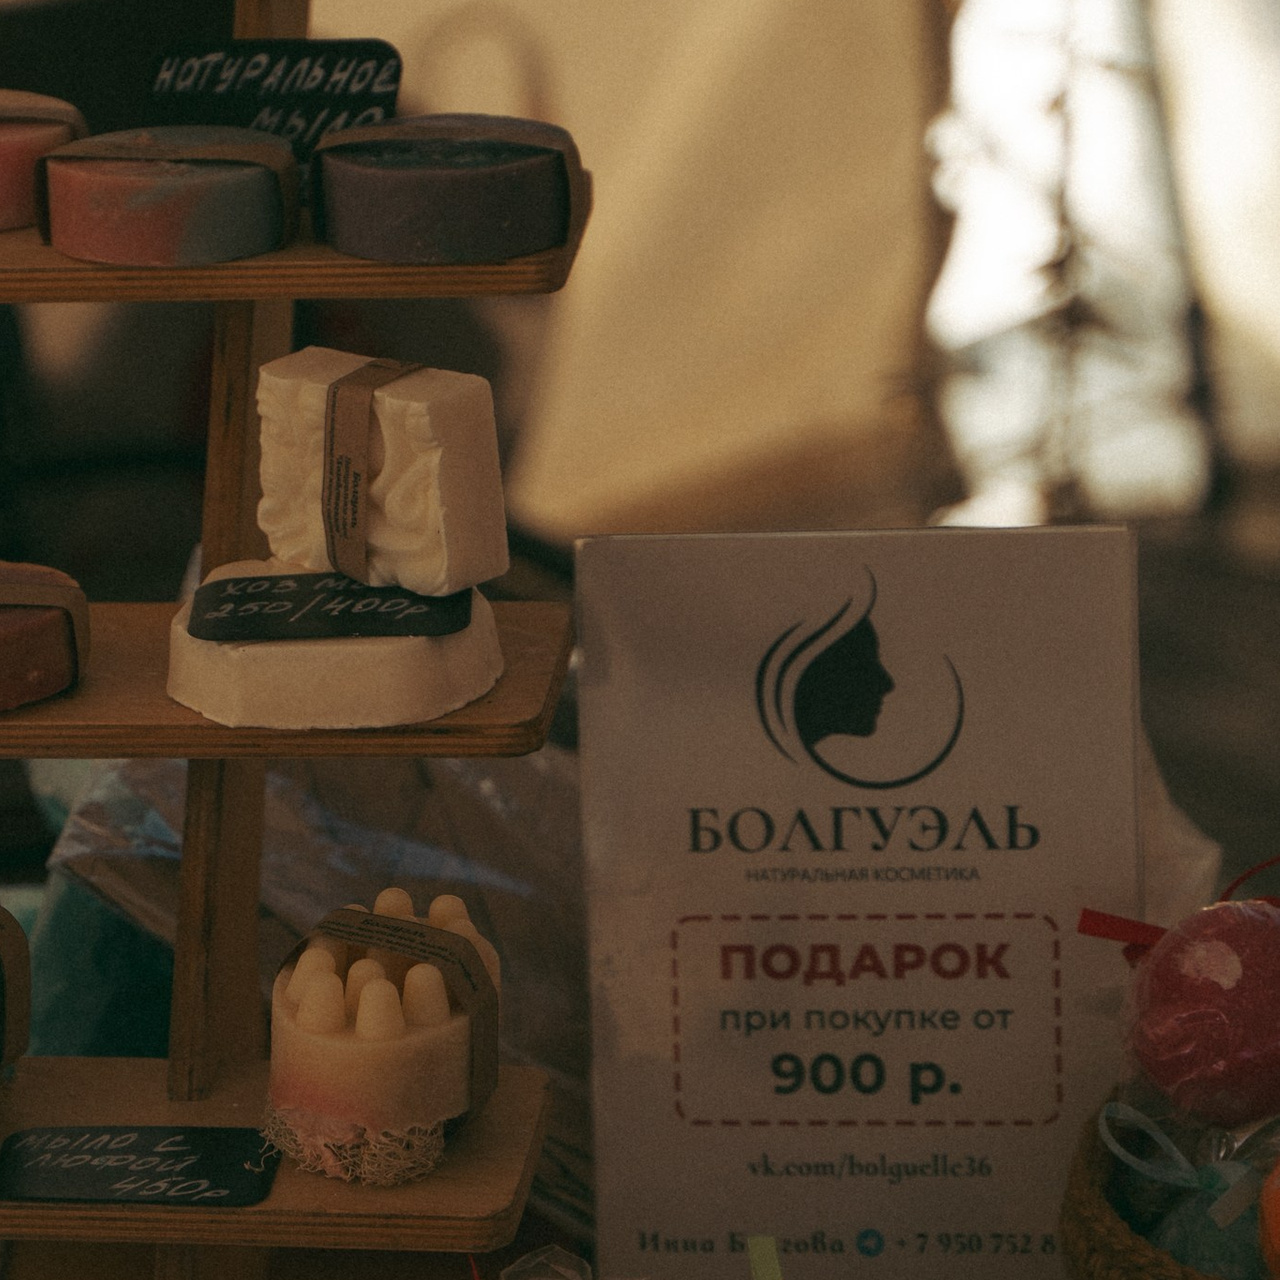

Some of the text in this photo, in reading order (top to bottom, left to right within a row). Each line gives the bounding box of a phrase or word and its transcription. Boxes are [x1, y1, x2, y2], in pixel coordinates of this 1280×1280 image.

[687, 806, 1041, 854] БОЛГУЭЛЬ
[745, 866, 981, 883] НАТУРАЛЬНАЯ КОСМЕТИКА
[720, 944, 1012, 987] ПОДАРОК
[720, 1009, 1014, 1037] при покупке от
[771, 1052, 963, 1106] 900 р.
[746, 1153, 994, 1185] vk.com/bolguelle36
[110, 1176, 230, 1200] 450р
[637, 1231, 714, 1254] Инна
[728, 1230, 846, 1256] Бгова
[937, 1233, 983, 1254] 950
[990, 1233, 1032, 1254] 752
